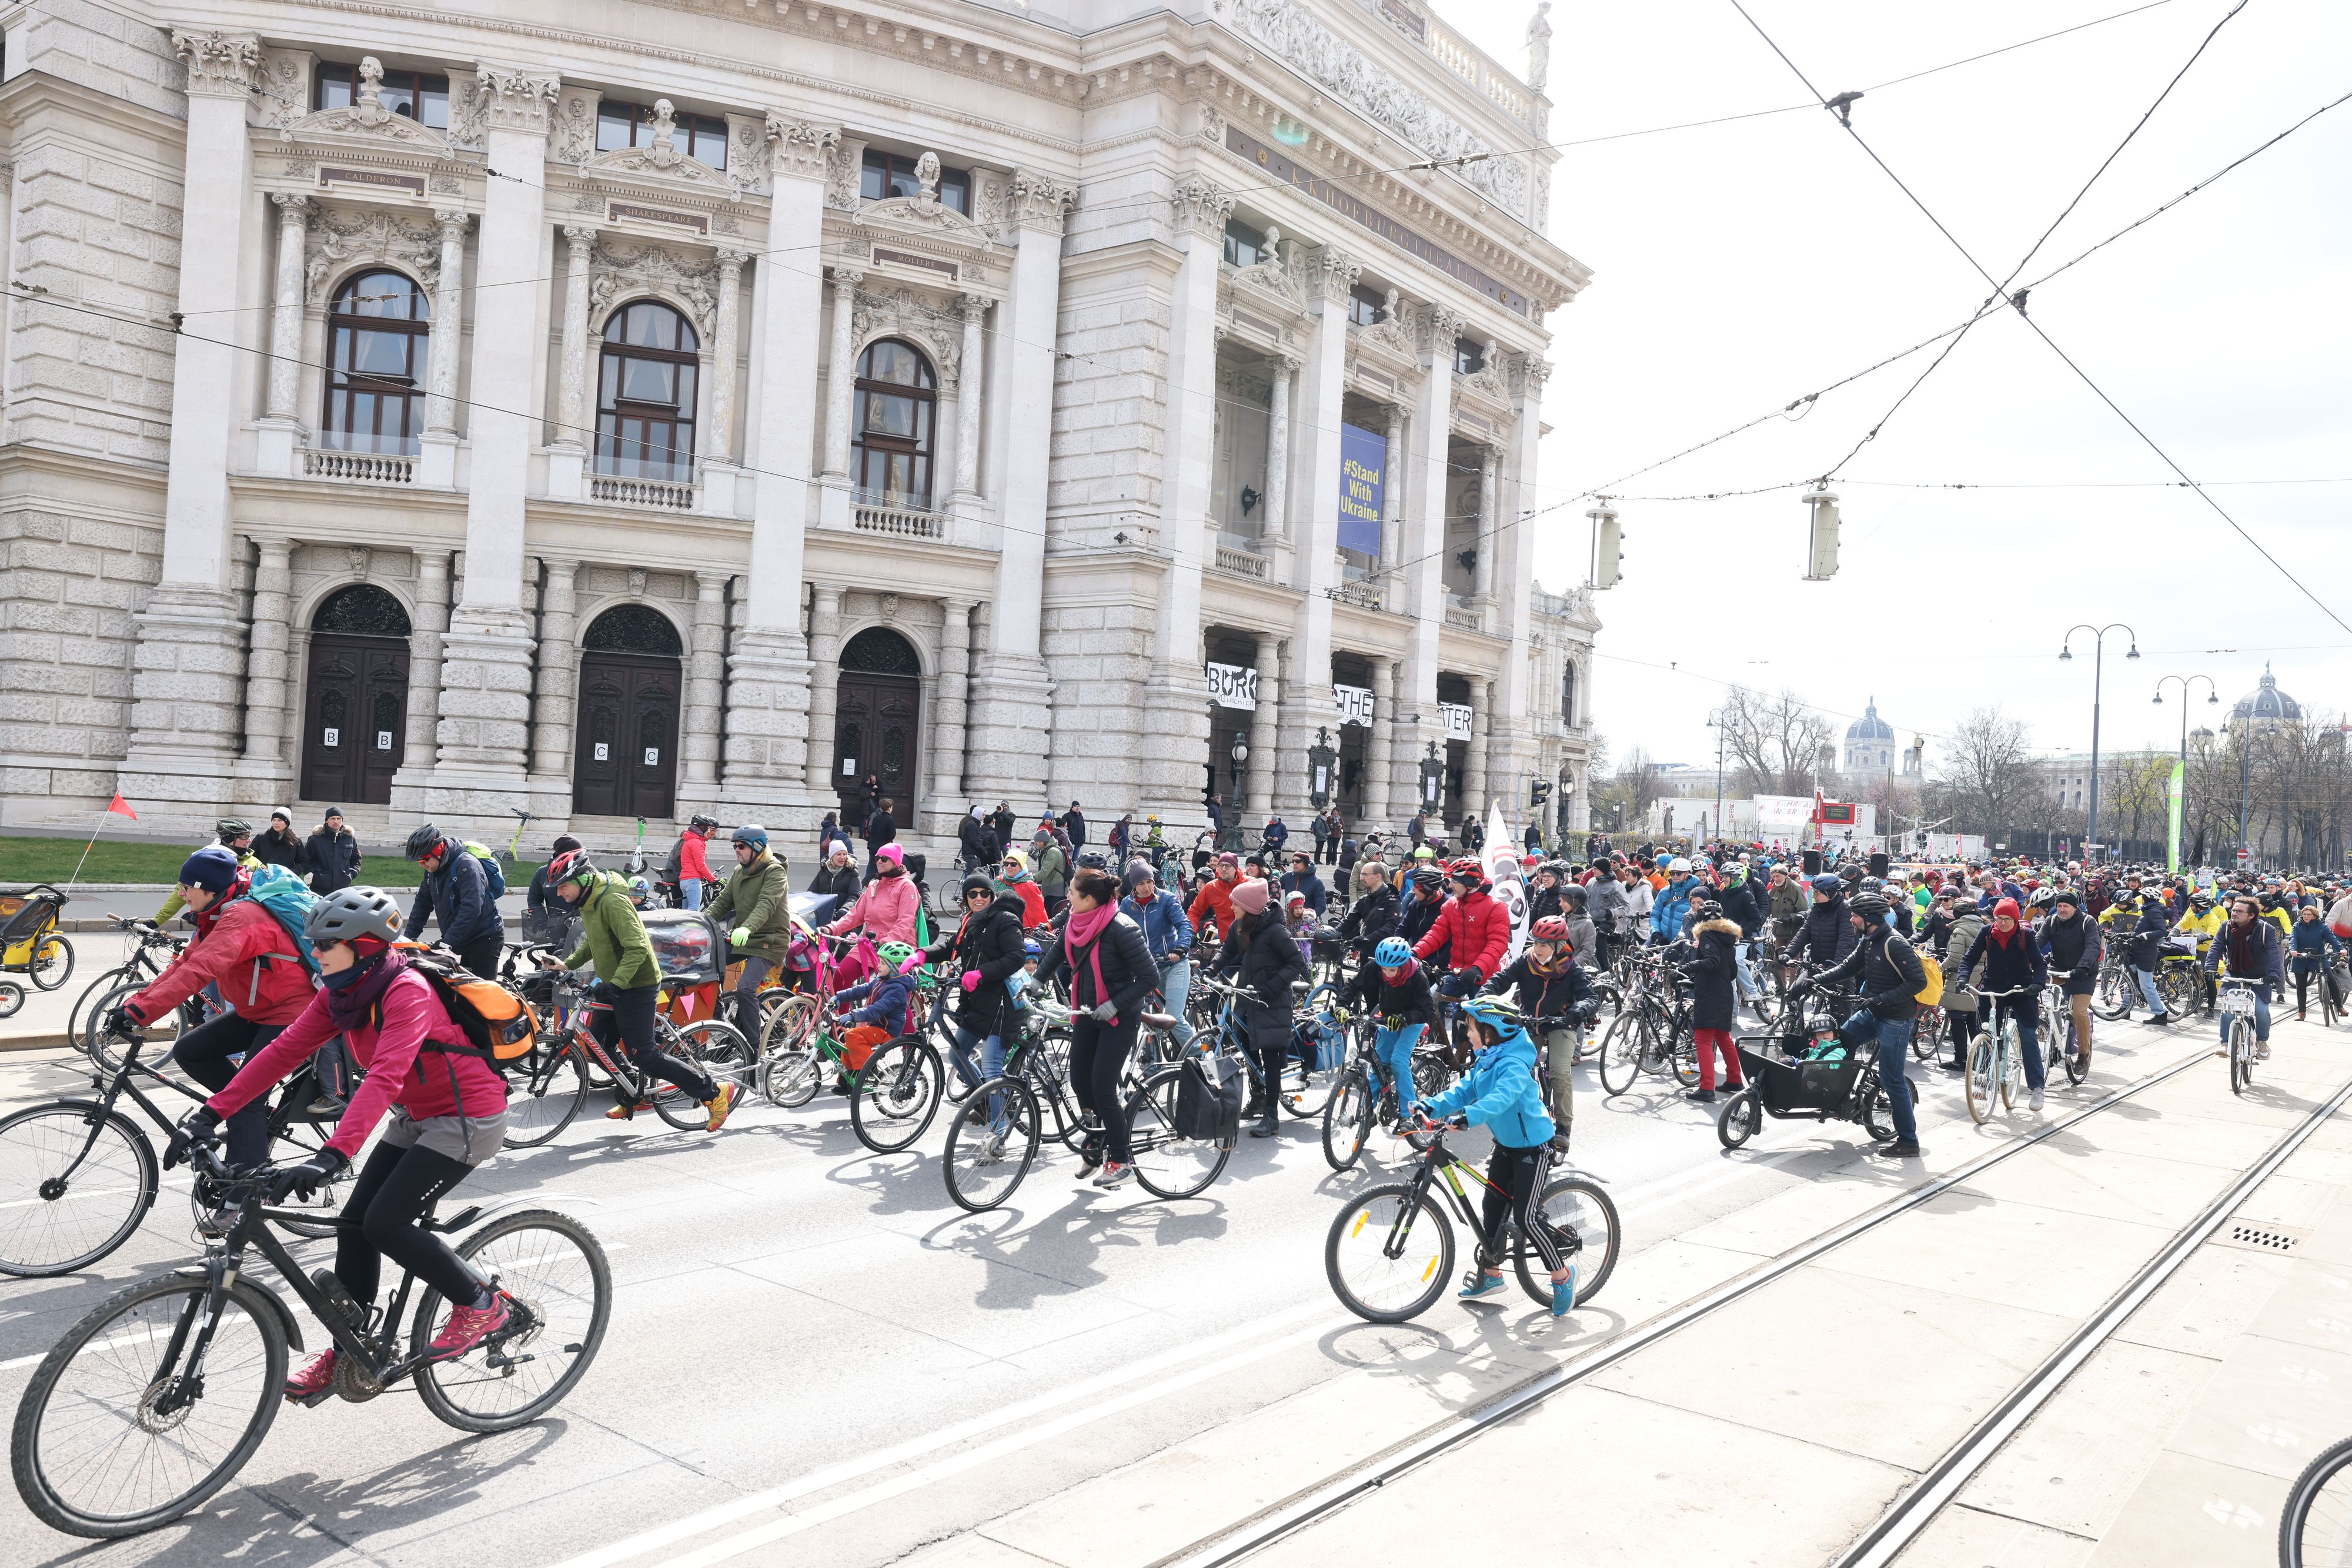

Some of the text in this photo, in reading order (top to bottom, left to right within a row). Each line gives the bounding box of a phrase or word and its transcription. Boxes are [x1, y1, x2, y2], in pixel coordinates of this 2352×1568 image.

[1344, 459, 1379, 485] #Stand
[1349, 479, 1372, 502] With
[1341, 495, 1378, 522] Ukraine
[1215, 694, 1254, 706] RGTHEATER
[1340, 690, 1372, 717] THE
[328, 733, 335, 742] B
[381, 735, 389, 745] B
[597, 747, 606, 757] C
[647, 751, 656, 761] C
[582, 1033, 617, 1072] SPECIALIZED
[1059, 1085, 1072, 1111] PUCH
[1448, 1166, 1463, 1193] CUBE
